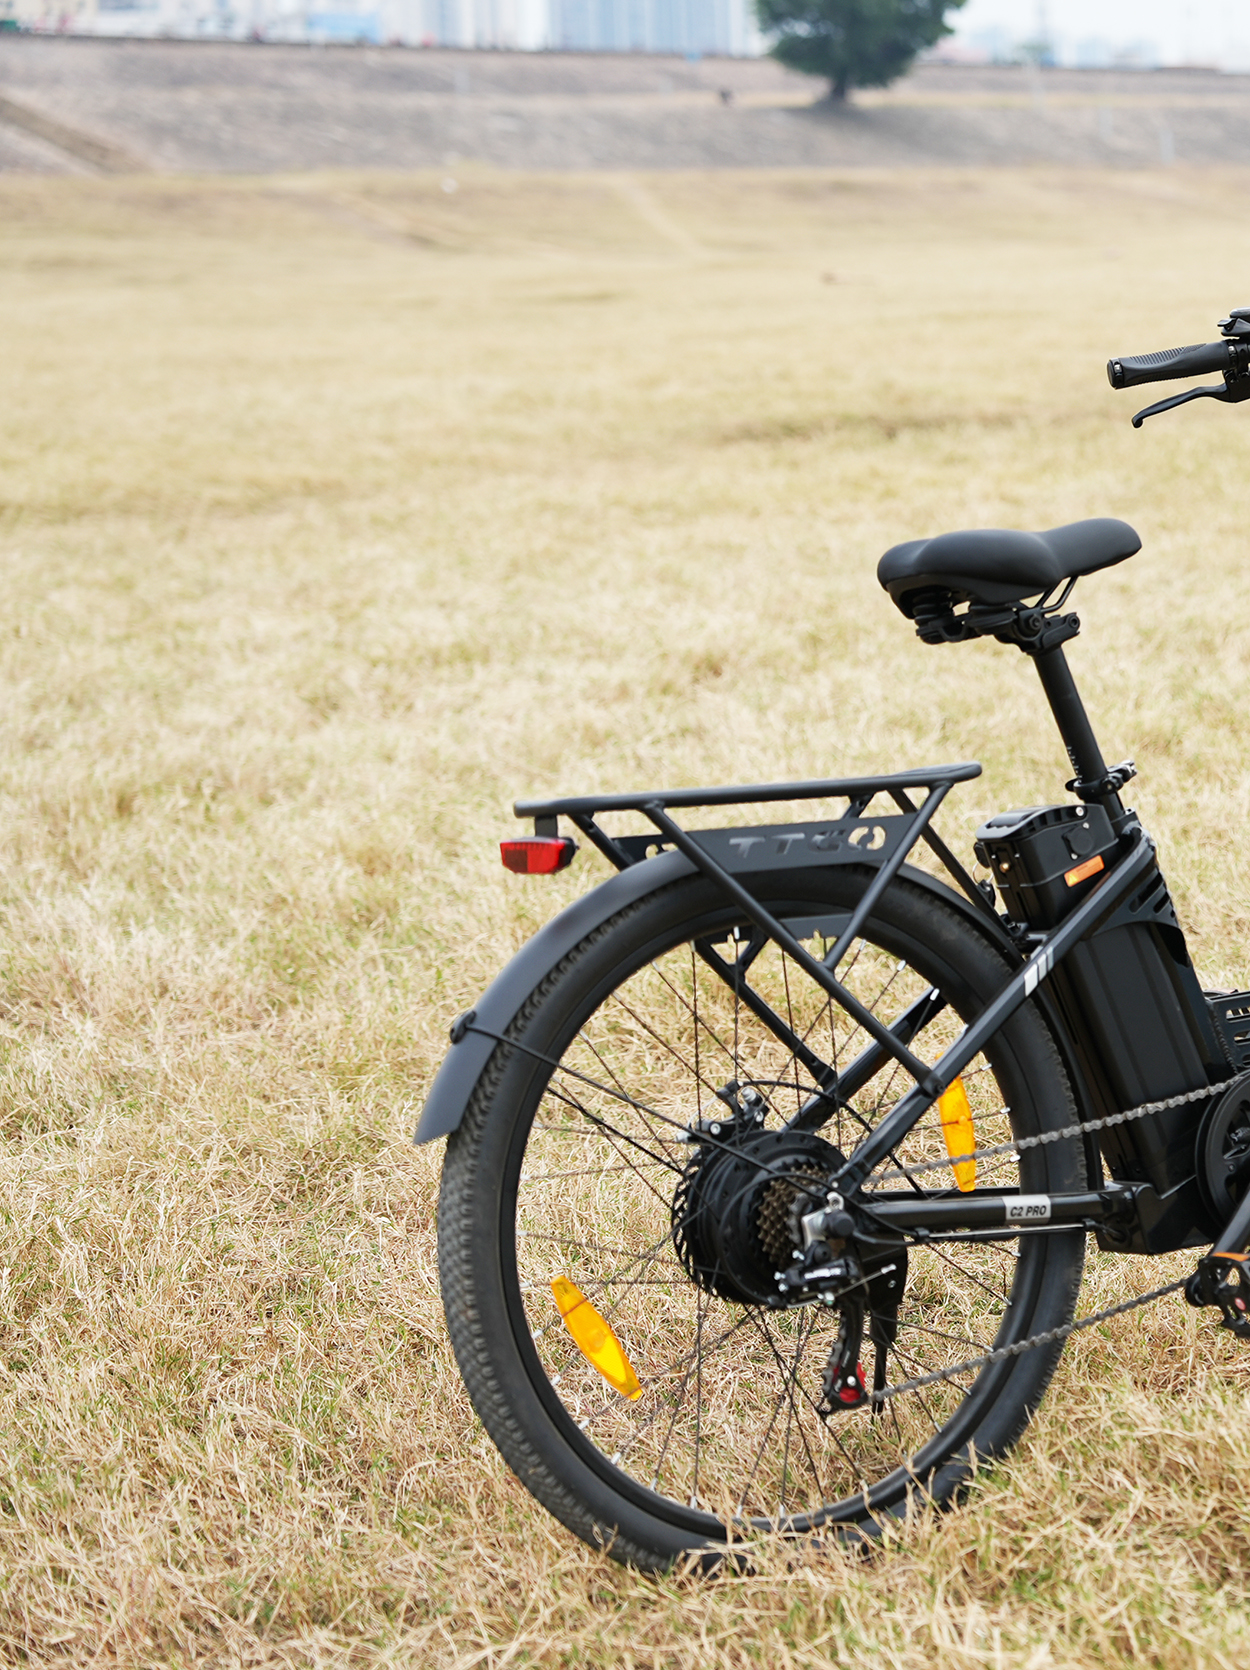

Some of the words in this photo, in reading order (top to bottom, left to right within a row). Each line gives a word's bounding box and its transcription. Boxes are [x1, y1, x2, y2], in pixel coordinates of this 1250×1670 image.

[729, 825, 887, 858] TTGO
[1010, 1206, 1024, 1217] C2
[1025, 1205, 1047, 1217] PRO
